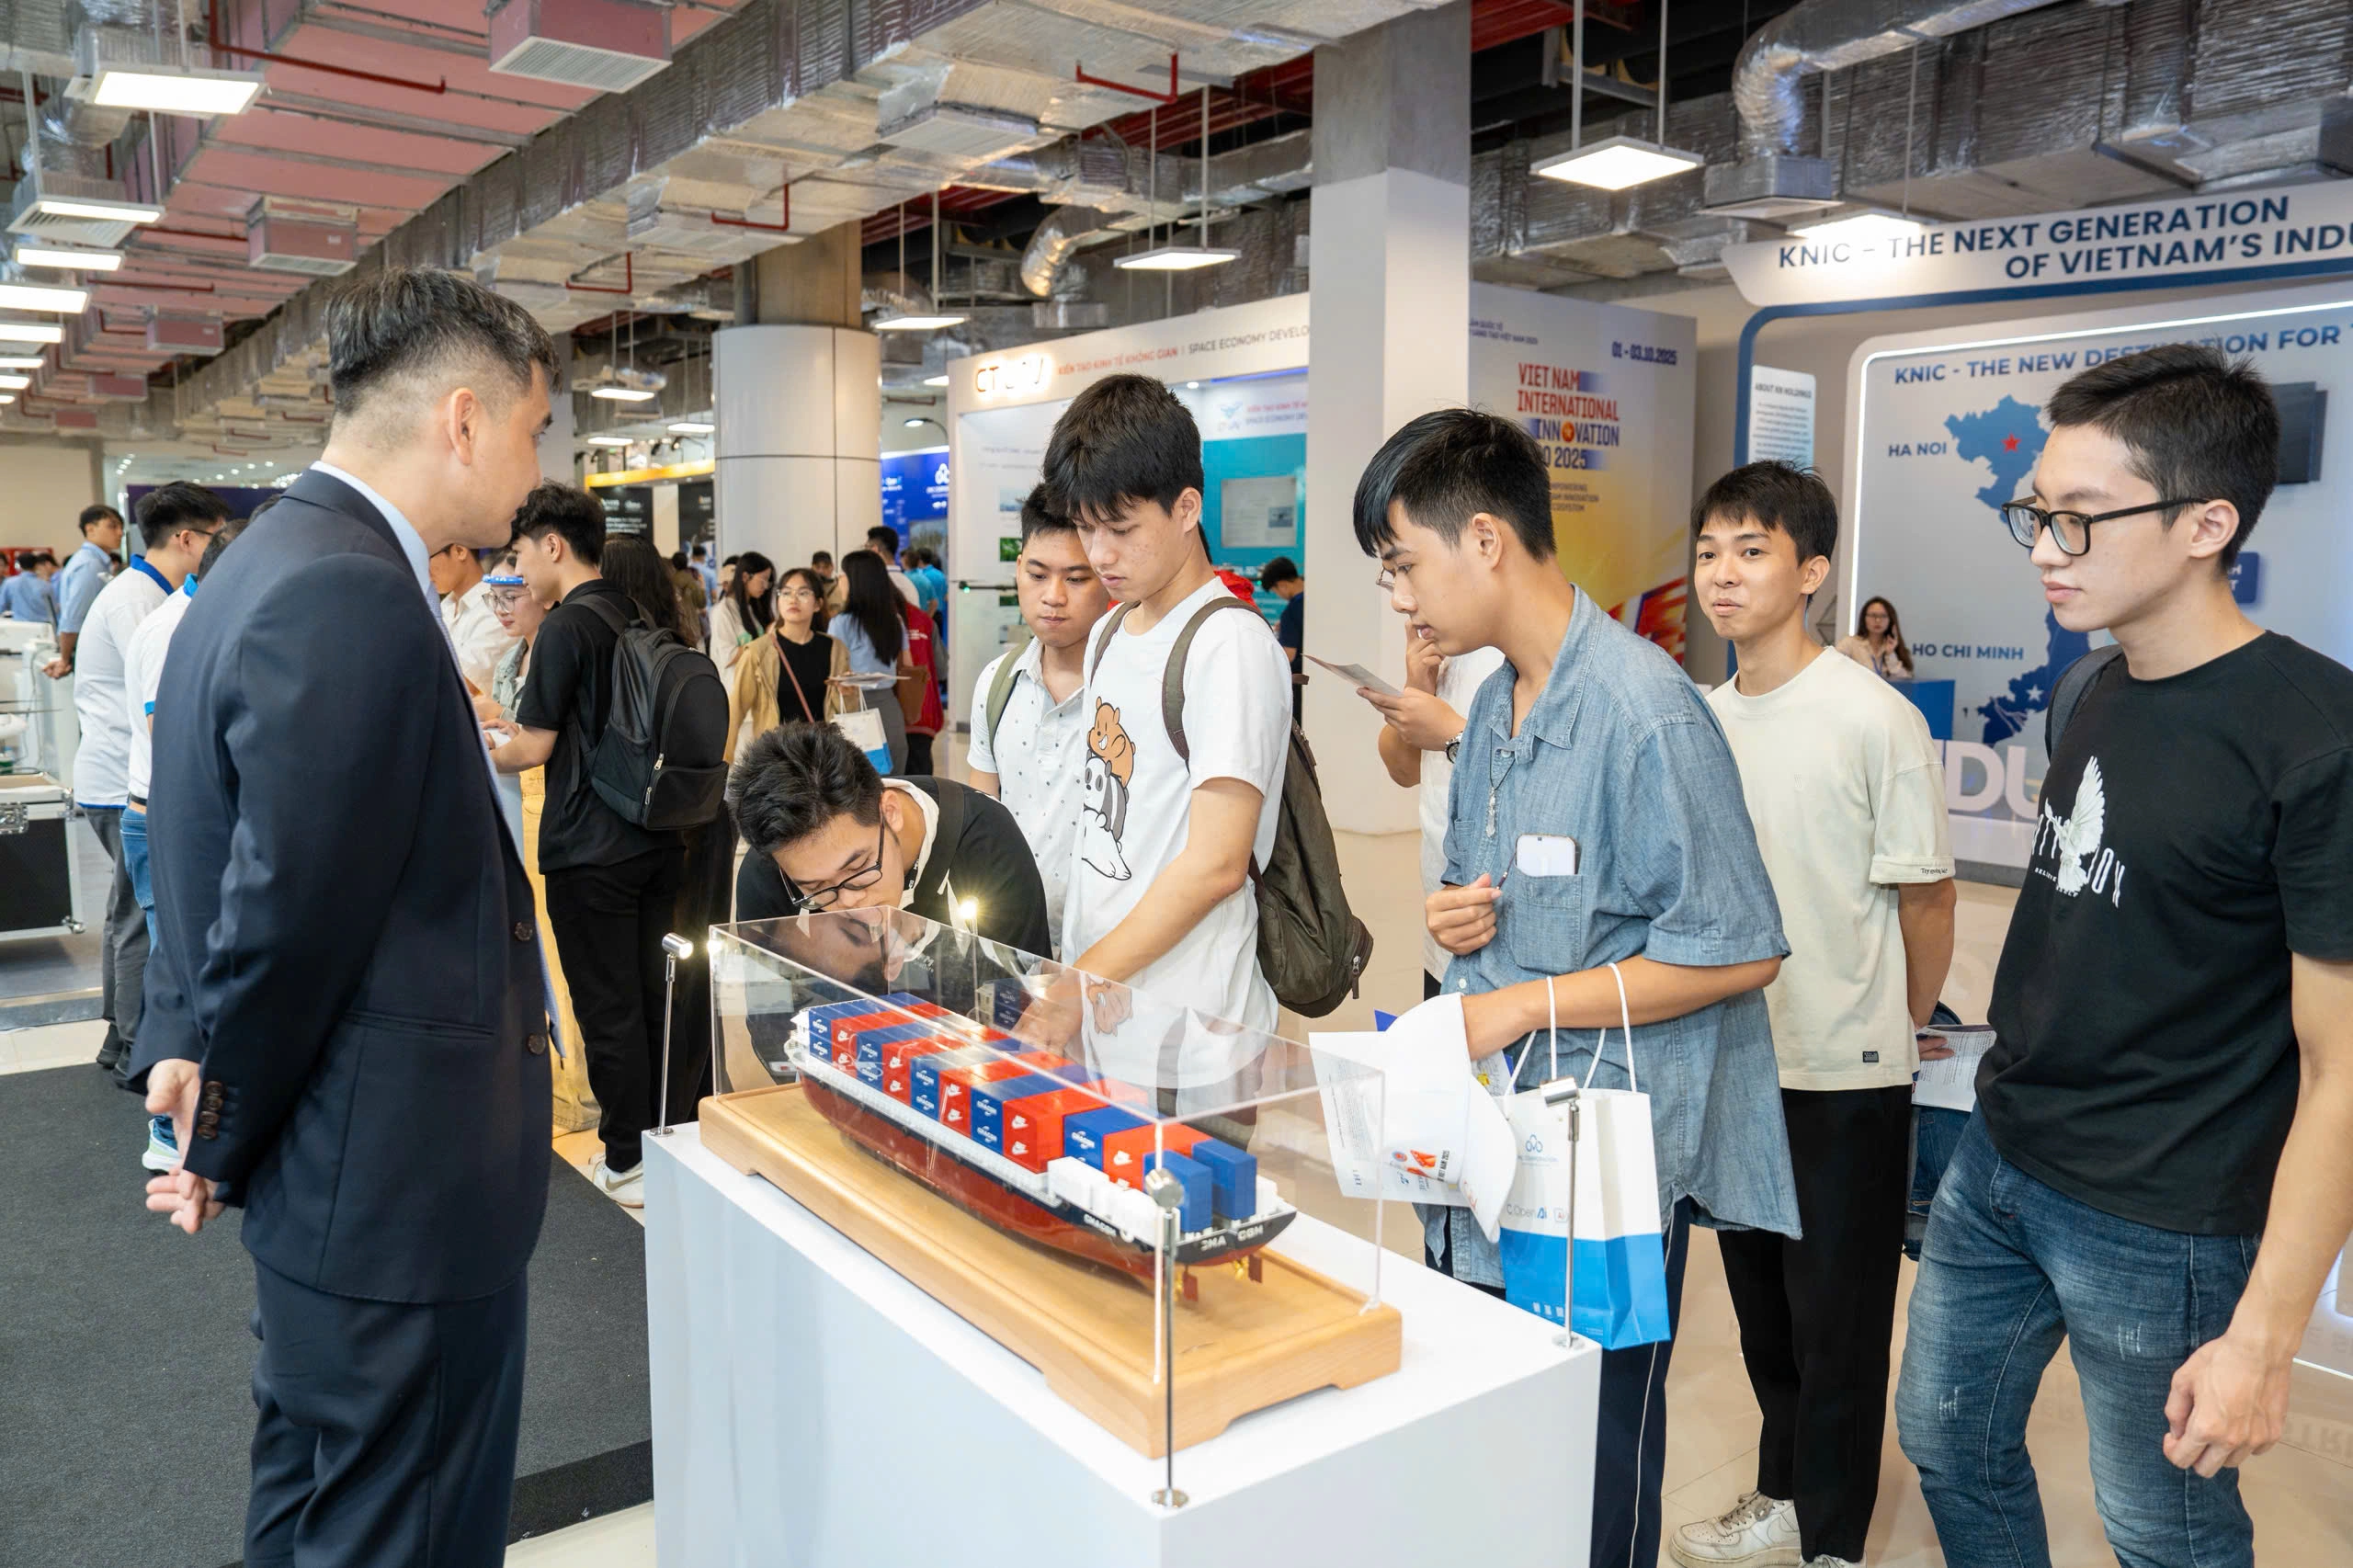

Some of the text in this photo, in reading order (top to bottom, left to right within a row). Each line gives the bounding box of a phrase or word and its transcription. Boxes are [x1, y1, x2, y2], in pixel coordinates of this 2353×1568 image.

[1779, 243, 1850, 267] KNIC
[1888, 233, 1943, 258] THE
[1954, 223, 2040, 253] NEXT
[2049, 196, 2290, 244] GENERATION
[2006, 253, 2050, 278] OF
[2274, 222, 2353, 255] IND
[1189, 339, 1216, 354] SPACE
[1220, 333, 1267, 350] ECONOMY
[1612, 341, 1622, 358] 01
[1630, 344, 1677, 366] 03.10.2025
[1894, 364, 1946, 383] KNIC
[1967, 358, 2011, 378] THE
[2018, 352, 2077, 373] NEW
[2278, 325, 2340, 349] FOR
[1518, 361, 1581, 392] VIET NAM
[1518, 390, 1620, 421] INTERNATIONAL
[1554, 446, 1588, 470] 2025
[1888, 442, 1948, 458] HA NOI
[1913, 643, 2024, 660] HO CHI MINH
